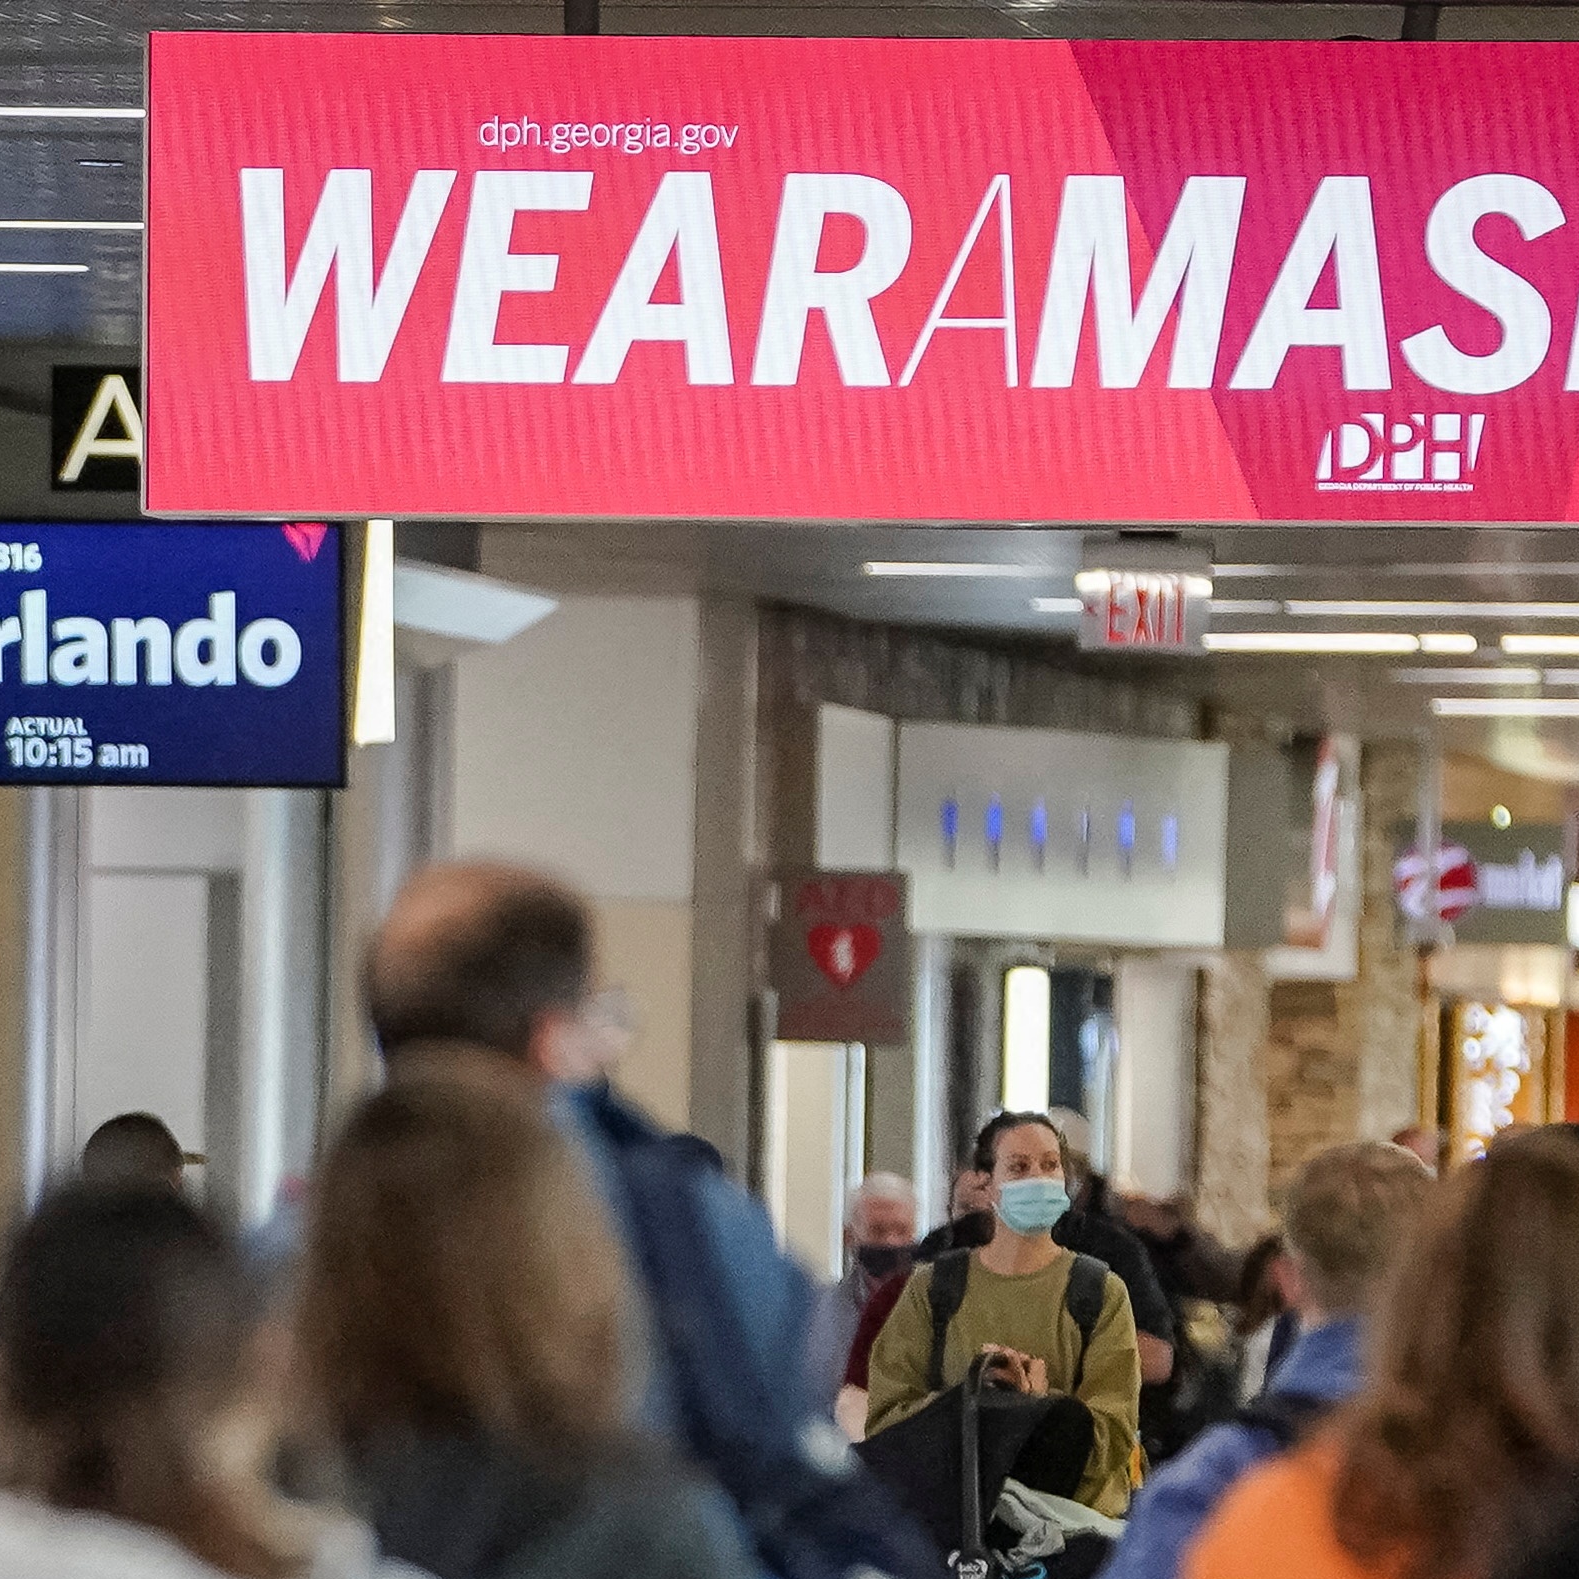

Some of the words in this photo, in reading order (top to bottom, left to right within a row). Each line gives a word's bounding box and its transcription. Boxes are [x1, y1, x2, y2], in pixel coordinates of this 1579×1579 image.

[479, 115, 739, 155] dph.georgia.gov
[5, 716, 89, 737] ACTUAL
[6, 736, 94, 768] 10:15
[95, 743, 150, 769] am
